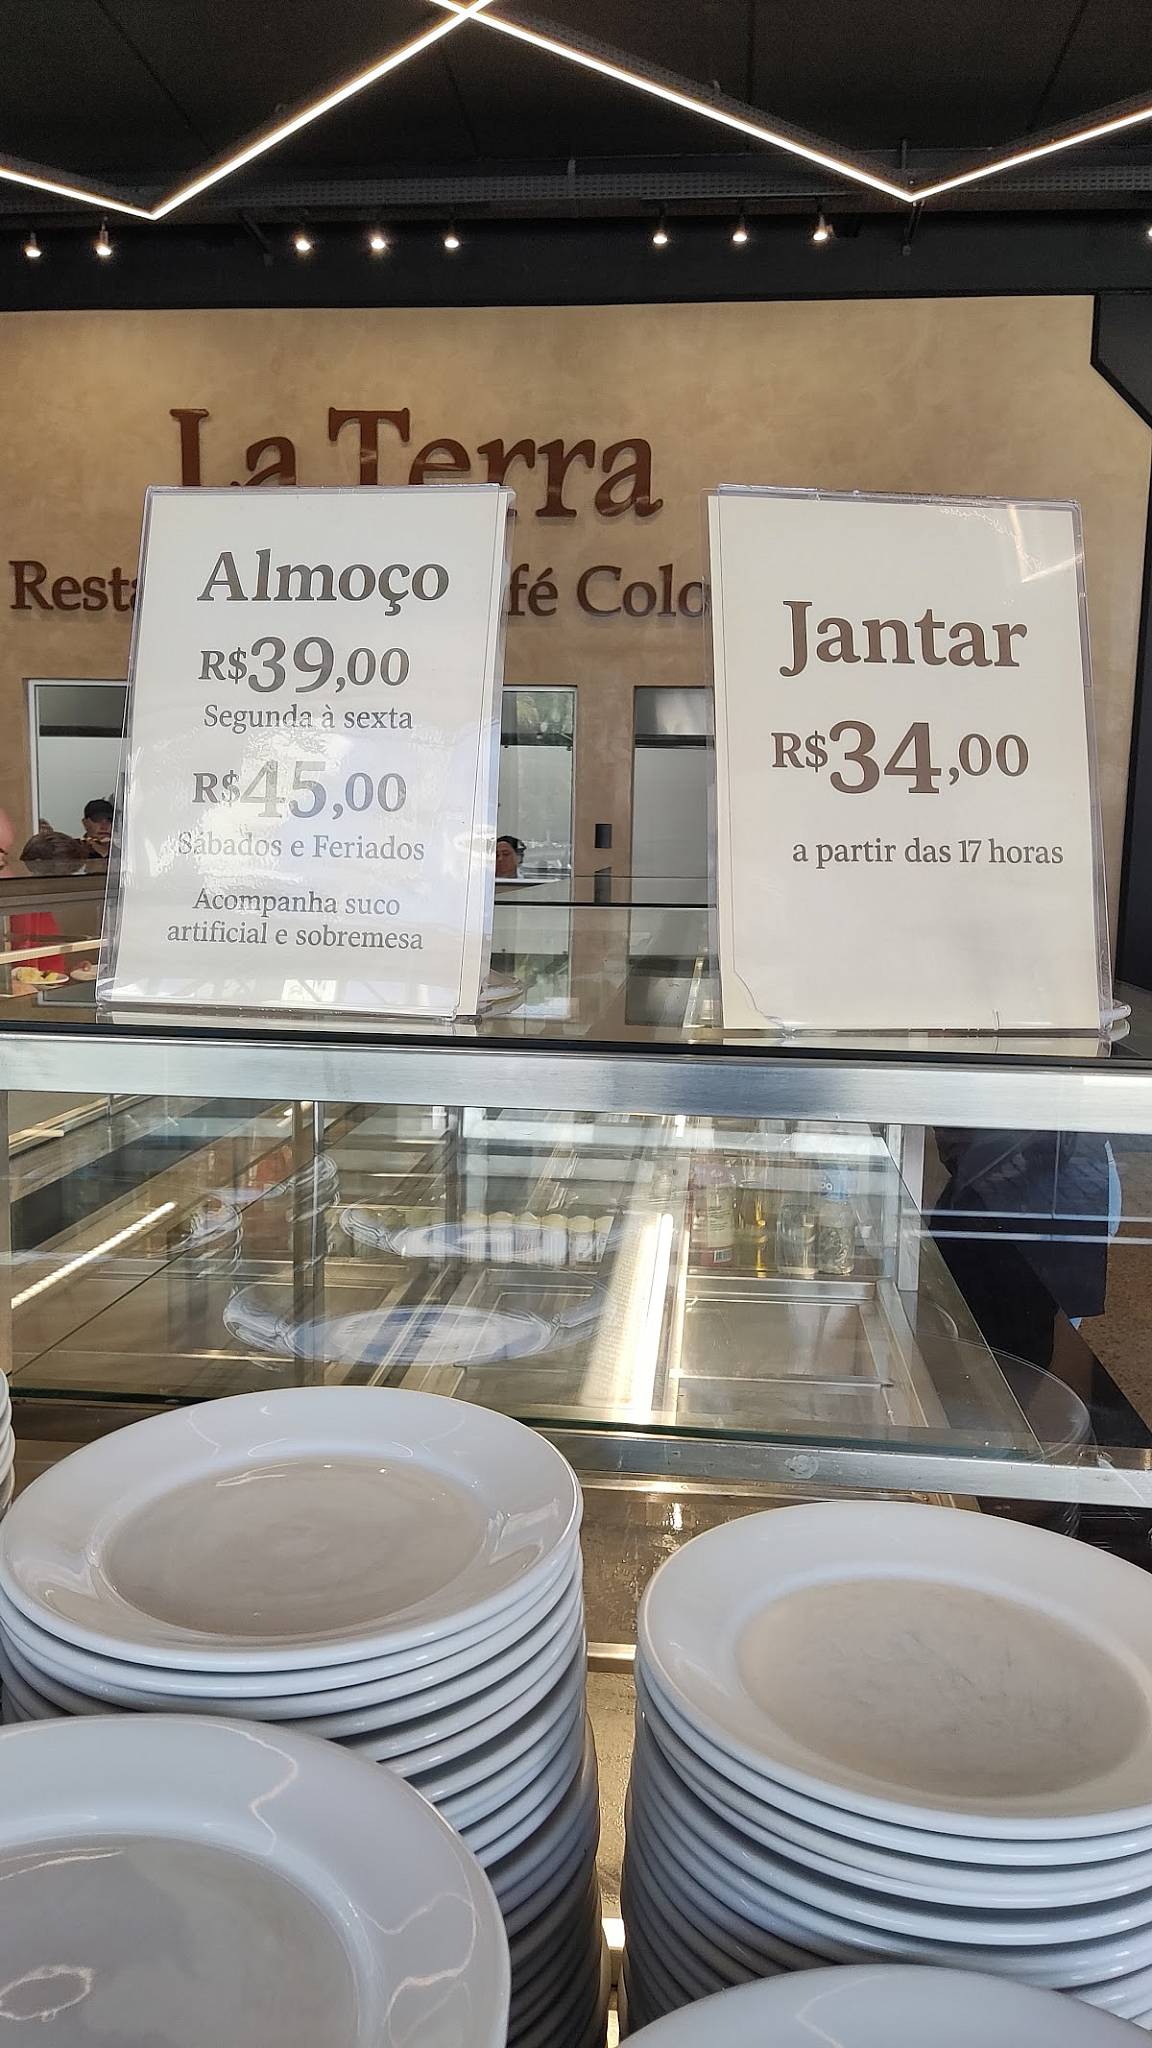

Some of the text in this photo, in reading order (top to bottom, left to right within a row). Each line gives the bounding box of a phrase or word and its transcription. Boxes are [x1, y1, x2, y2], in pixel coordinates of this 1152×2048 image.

[328, 407, 664, 517] Terra
[8, 560, 137, 611] Rest
[197, 548, 450, 616] Almoço
[198, 636, 410, 693] R$39,00
[779, 600, 1028, 677] Jantar
[203, 703, 413, 735] Segunda à sexta
[771, 720, 1029, 794] R$34,00
[192, 760, 407, 820] R$45,00
[178, 831, 425, 861] Sábados e Feriados
[792, 837, 1064, 869] a partir das 17 horas
[192, 887, 401, 918] Acompanha suco
[167, 920, 424, 950] artificial e sobremesa
